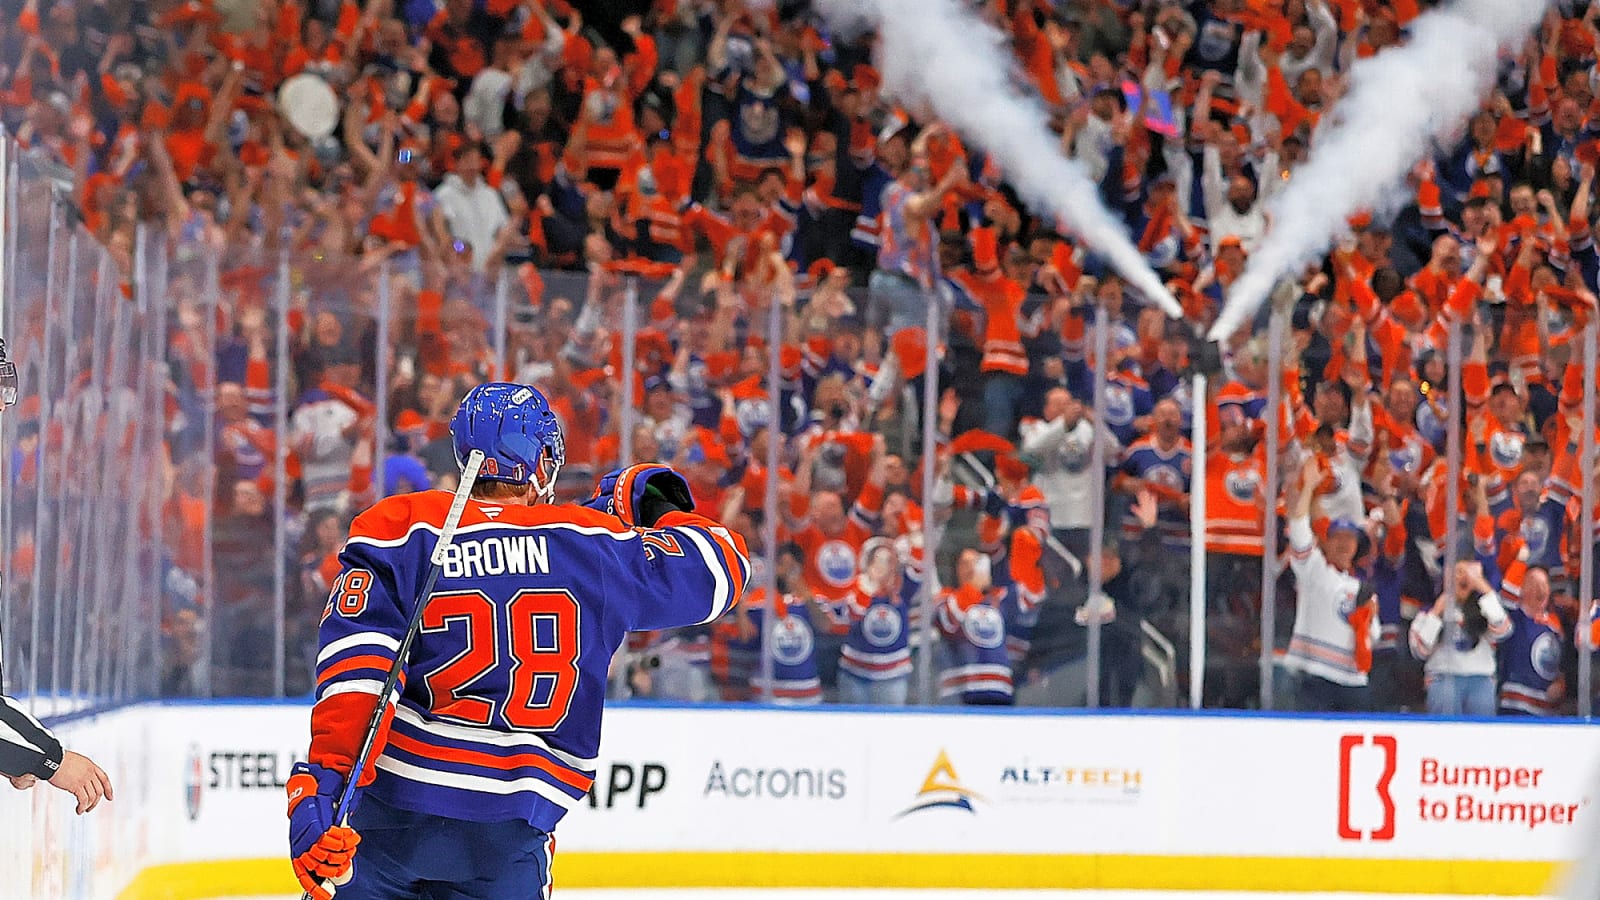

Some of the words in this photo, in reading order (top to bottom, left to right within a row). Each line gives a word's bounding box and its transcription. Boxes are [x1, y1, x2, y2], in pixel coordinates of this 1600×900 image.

[479, 457, 499, 475] 28
[441, 535, 549, 578] BROWN
[418, 588, 582, 733] 28
[209, 751, 309, 789] STEEL
[587, 763, 666, 808] PP
[703, 760, 847, 799] Acronis
[1420, 758, 1544, 792] Bumper
[1418, 796, 1448, 820] to
[1455, 795, 1578, 829] Bumper
